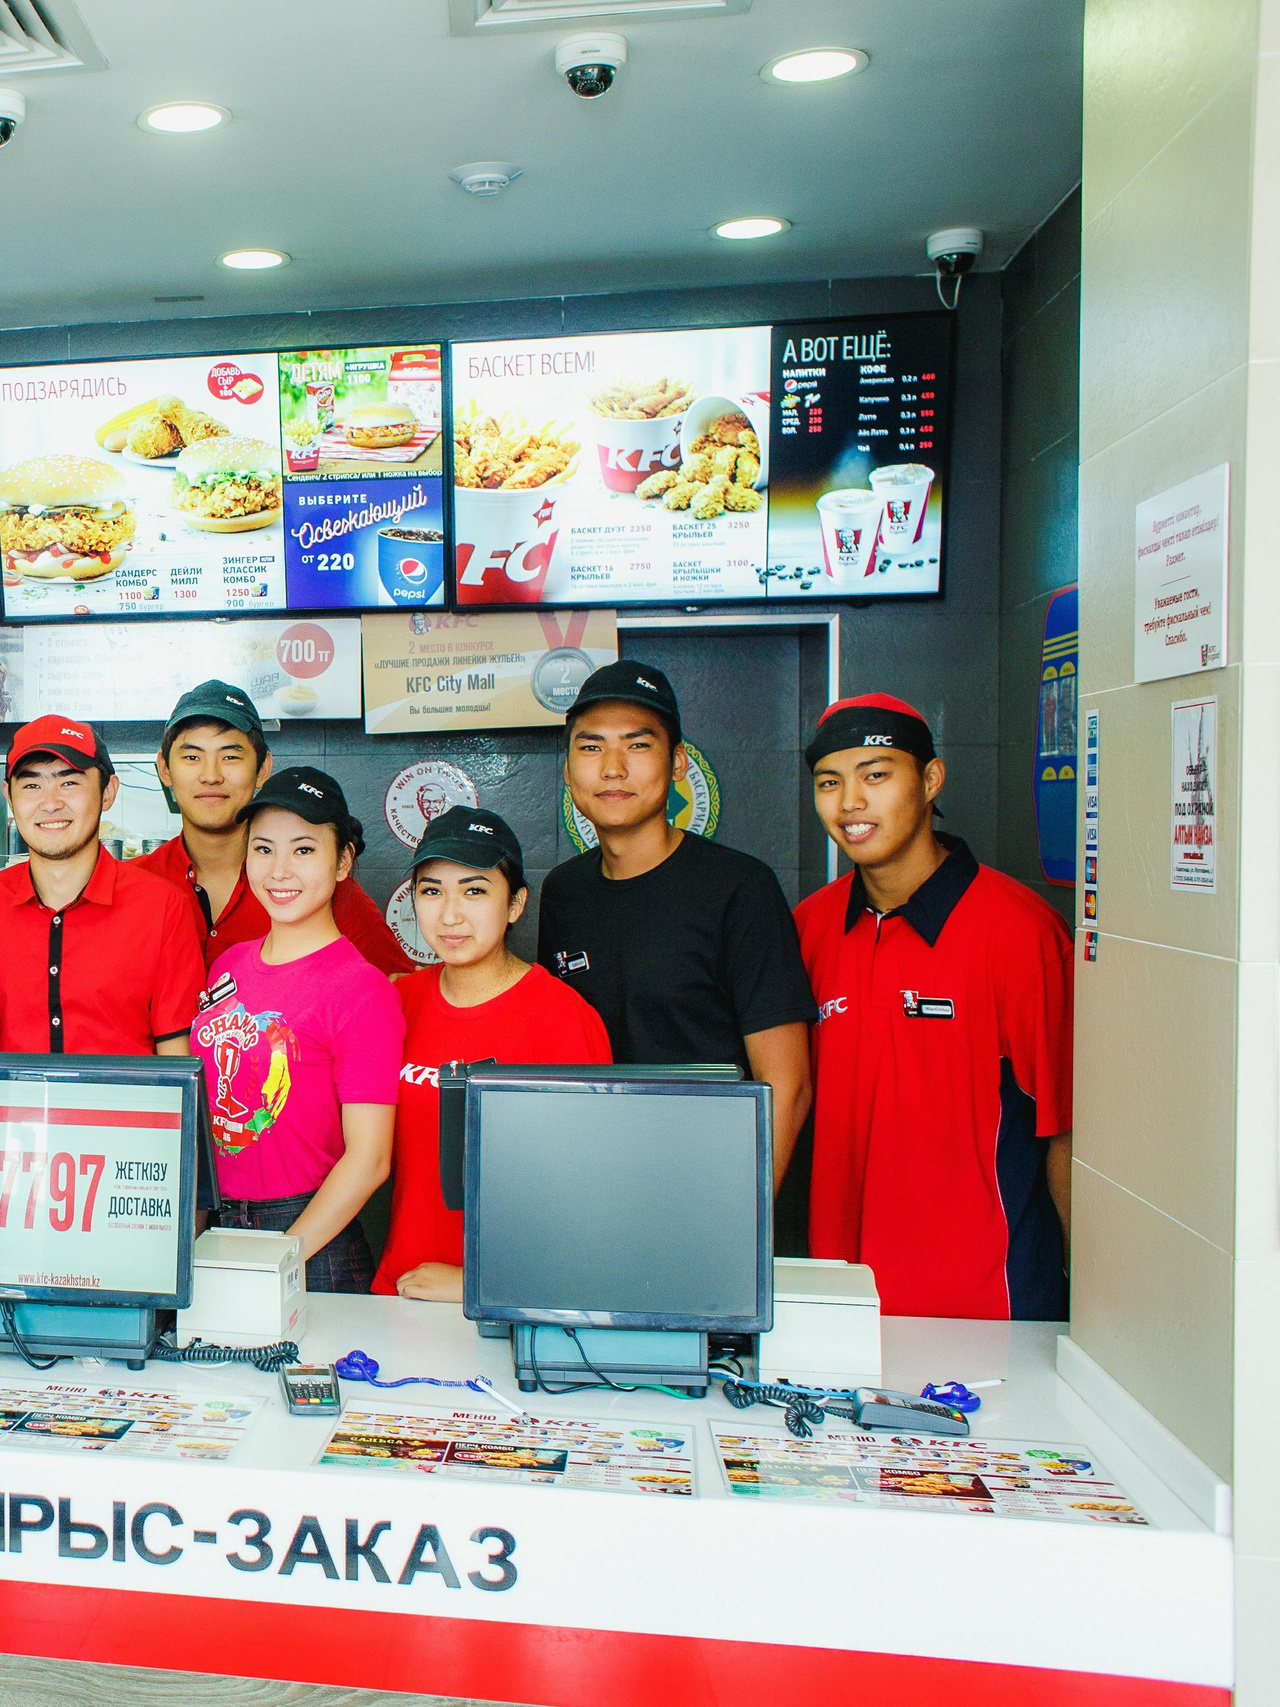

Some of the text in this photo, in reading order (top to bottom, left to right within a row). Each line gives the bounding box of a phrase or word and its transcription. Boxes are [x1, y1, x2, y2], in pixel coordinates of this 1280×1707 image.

[783, 330, 891, 363] А ВОТ ЕЩЁ:
[468, 350, 596, 379] БАСКЕТ ВСЕМ!
[860, 364, 887, 375] КОФЕ
[210, 367, 241, 378] ДОБАВЬ
[291, 363, 342, 383] ДЕТЯМ
[782, 368, 826, 379] НАПИТКИ
[217, 376, 234, 385] СЫР
[346, 374, 371, 384] 1100
[1, 375, 128, 403] ПОДЗАРЯДИСЬ
[418, 470, 442, 478] выбор
[299, 494, 367, 505] ВЫБЕРИТЕ
[291, 484, 429, 549] Освежающий
[604, 526, 626, 534] ДУЭТ
[728, 521, 750, 529] 3250
[673, 531, 713, 539] КРЫЛЬЕВ
[222, 556, 258, 565] ЗИНГЕР
[317, 553, 355, 571] 220
[115, 569, 158, 579] САНДЕРС
[170, 566, 203, 577] ДЕЙЛИ
[223, 565, 267, 574] КЛАССИК
[673, 567, 721, 575] КРЫЛЫШКИ
[116, 579, 148, 587] КОМБО
[171, 578, 198, 586] МИЛЛ
[223, 576, 256, 584] КОМБО
[571, 573, 611, 581] КРЫЛЬЕВ
[119, 592, 142, 600] 1100
[174, 590, 197, 598] 1300
[226, 589, 249, 597] 1250
[393, 588, 425, 600] pepsi
[119, 602, 164, 611] 750 бургер
[226, 599, 274, 608] 900 бургер
[435, 613, 480, 630] KFC
[280, 639, 315, 663] 700
[408, 641, 494, 654] 2 МЕСТО В КОНКУРСЕ
[374, 653, 526, 670] «ЛУЧШИЕ ПРОДАЖИ ЛИНЕЙКИ ЖУЛЬЕН»
[560, 665, 571, 684] 2
[406, 673, 495, 694] KFC City Mall
[636, 677, 658, 692] KFC
[410, 702, 491, 715] Вы большие молодцы!
[61, 728, 84, 740] KFC
[864, 735, 893, 745] KFC
[298, 782, 324, 799] KFC
[390, 808, 422, 845] КАЧЕСТВО
[468, 823, 494, 836] KFC
[1087, 828, 1097, 840] VISA
[395, 885, 412, 903] WIN
[390, 922, 424, 959] КАЧЕСТВО
[818, 996, 848, 1024] KFC
[198, 1013, 259, 1050] CHAMPS
[225, 1047, 235, 1076] 1
[115, 1160, 168, 1182] ЖЕТКІЗУ
[108, 1196, 172, 1218] ДОСТАВКА
[18, 1272, 100, 1289] www.kfc-kazakhstan.kz
[46, 1384, 181, 1401] МЕНЮ KFC
[452, 1411, 600, 1429] МЕНЮ KFC
[827, 1433, 988, 1450] МЕНЮ KFC
